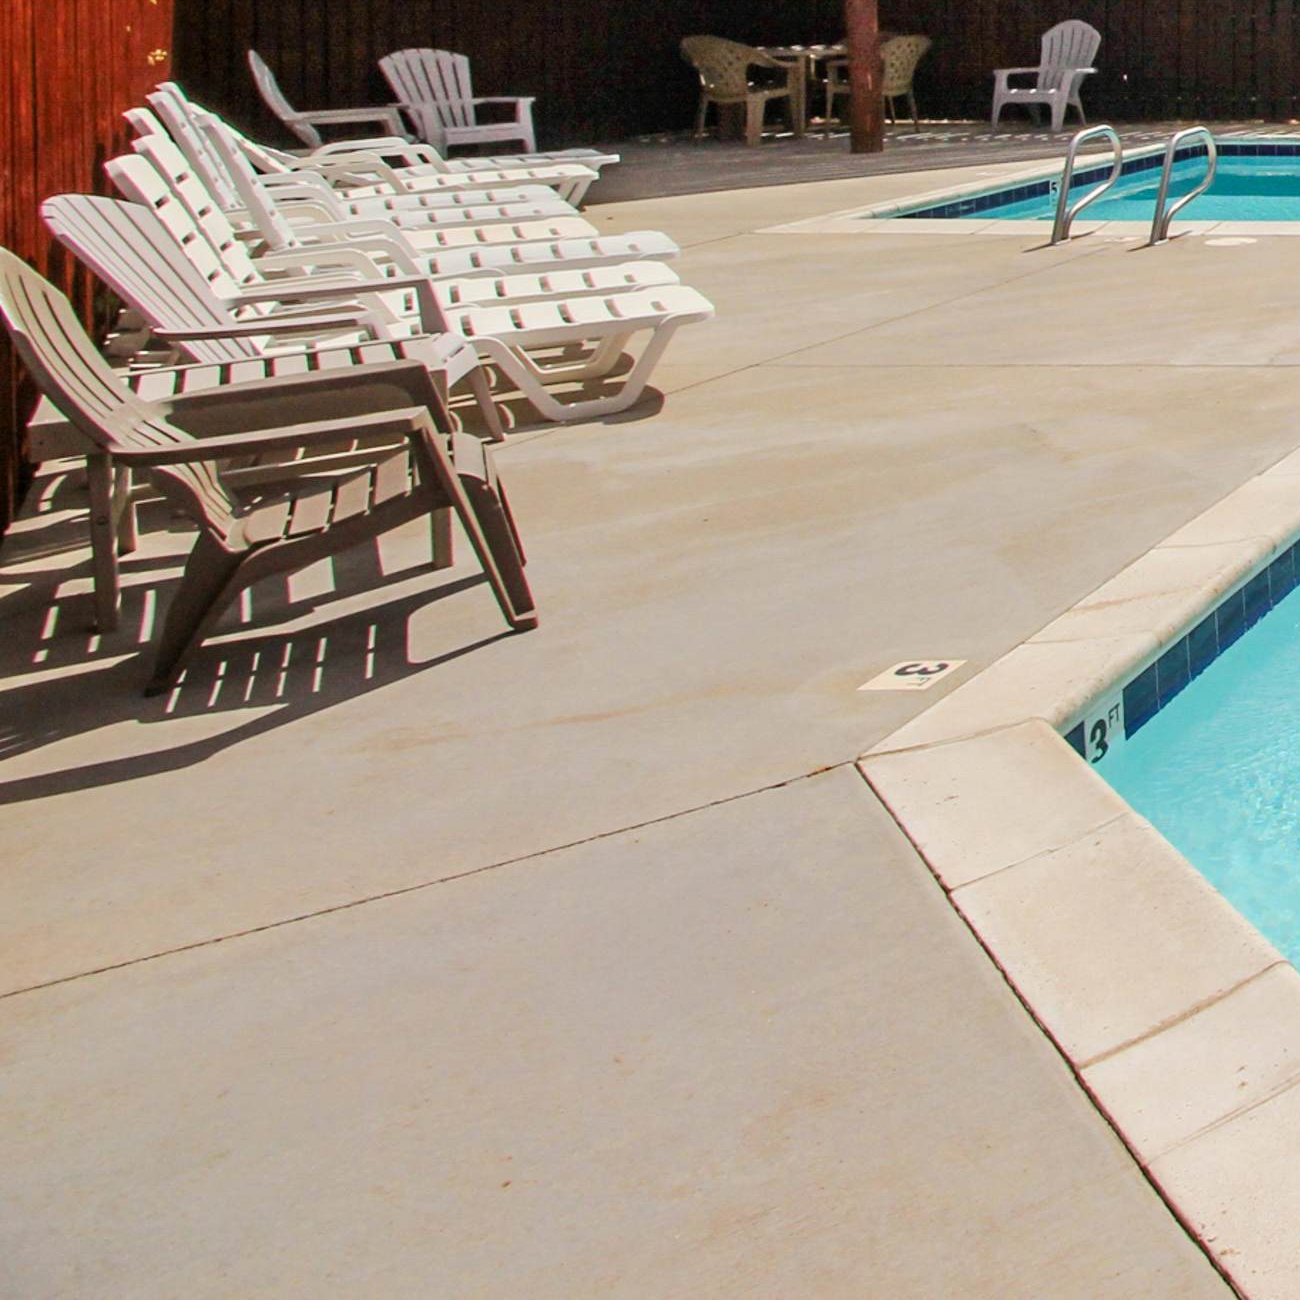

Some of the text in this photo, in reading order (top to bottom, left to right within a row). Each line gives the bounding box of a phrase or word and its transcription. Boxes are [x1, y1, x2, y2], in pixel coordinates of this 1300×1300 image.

[894, 662, 950, 677] 3
[1089, 702, 1121, 764] 3 FT
